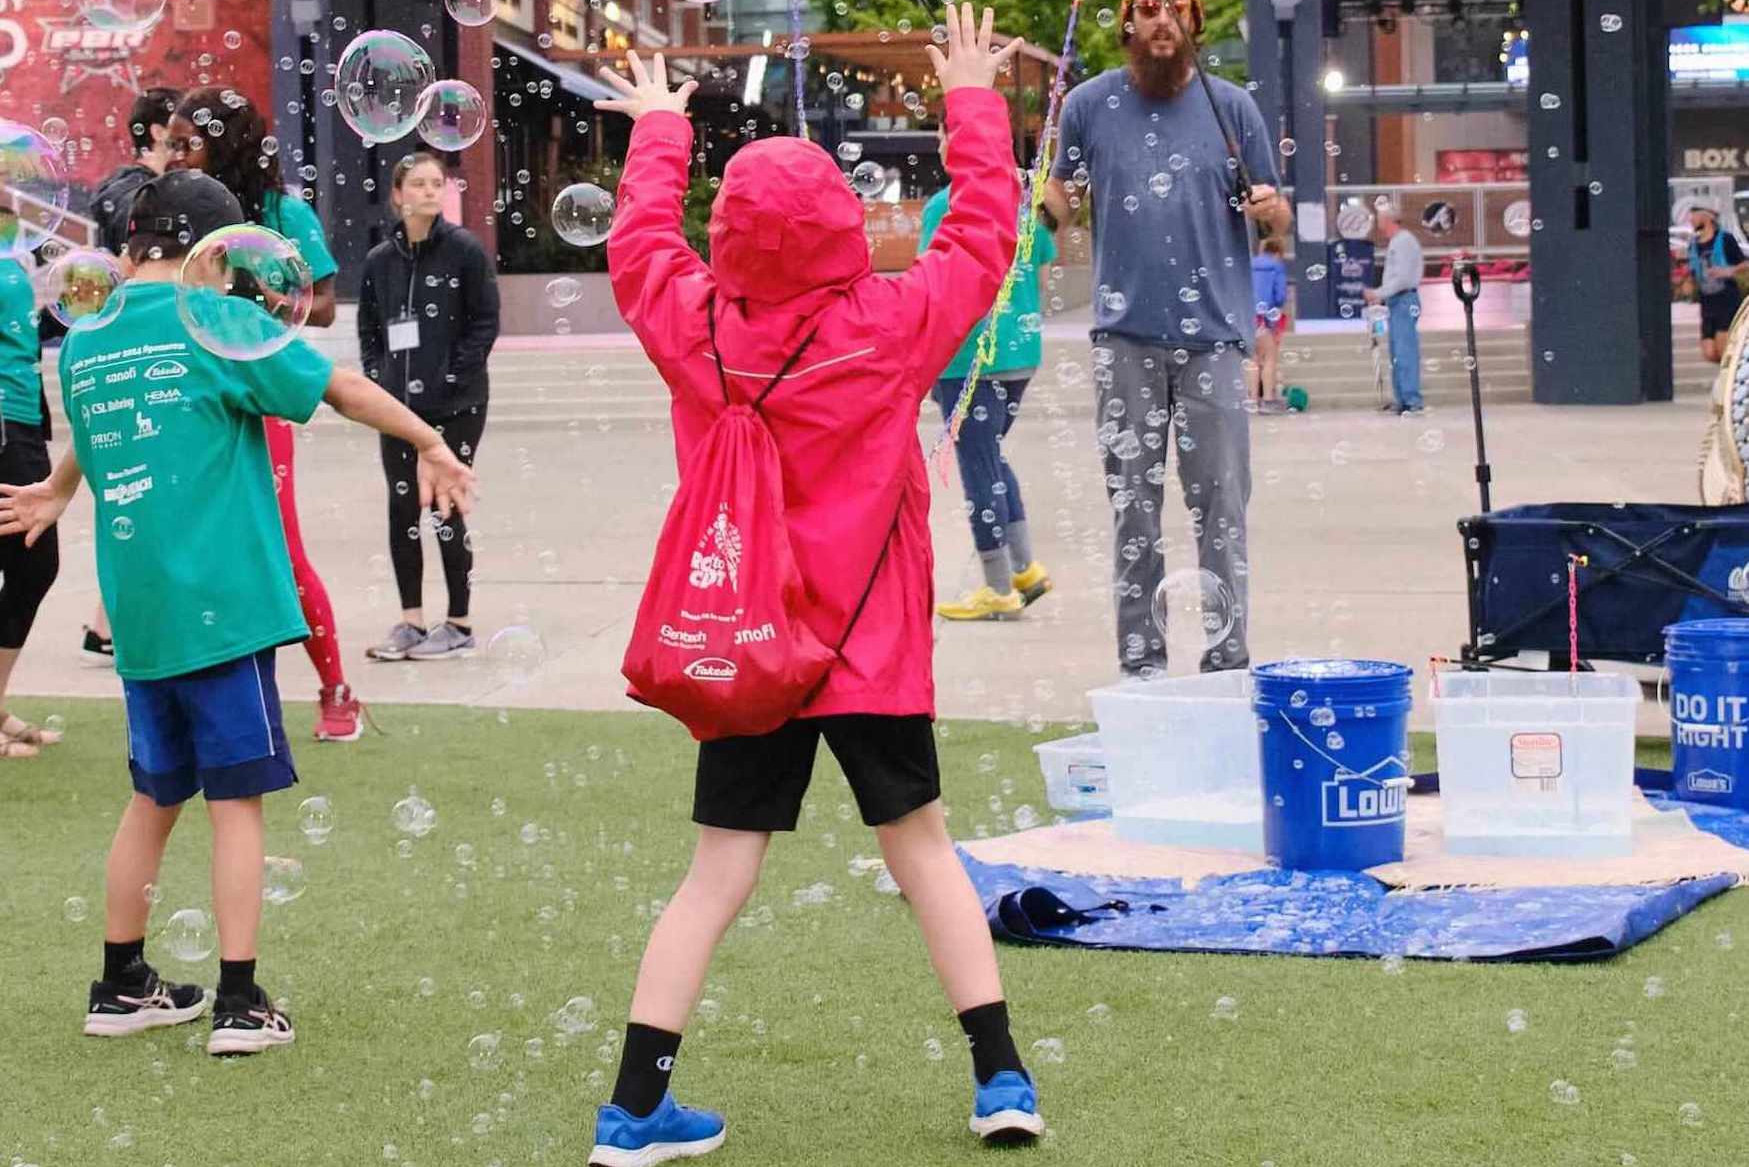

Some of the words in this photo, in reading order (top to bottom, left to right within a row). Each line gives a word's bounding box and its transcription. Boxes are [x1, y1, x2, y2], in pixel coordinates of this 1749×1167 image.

[1684, 149, 1739, 170] BOX
[105, 366, 137, 385] sanofi
[1676, 693, 1708, 722] DO
[1717, 695, 1749, 722] IT
[1677, 722, 1749, 750] RIGHT
